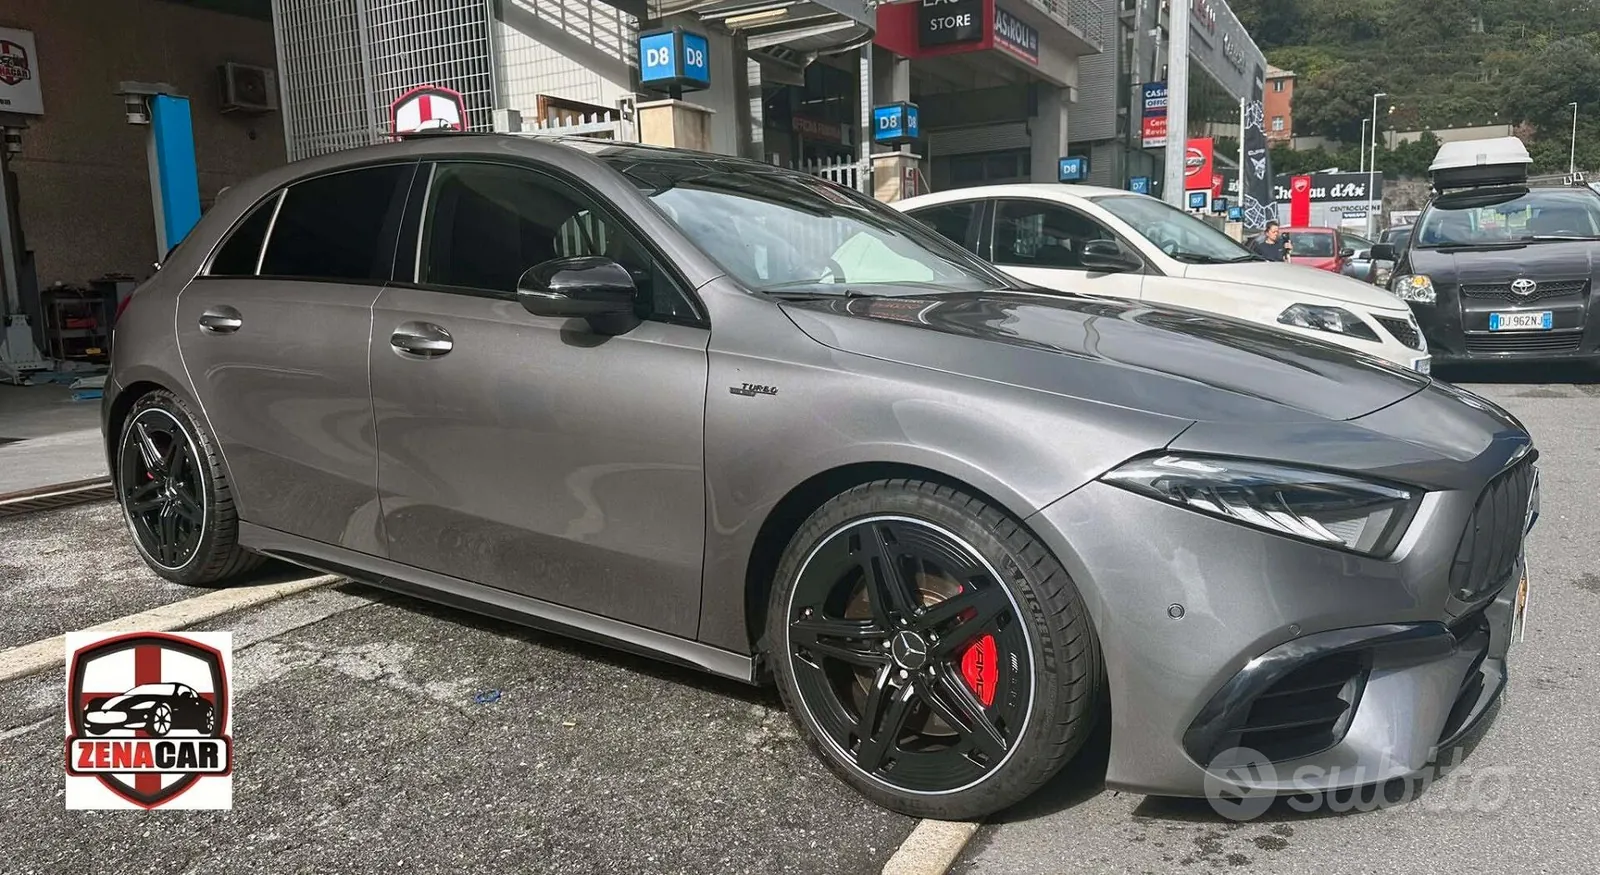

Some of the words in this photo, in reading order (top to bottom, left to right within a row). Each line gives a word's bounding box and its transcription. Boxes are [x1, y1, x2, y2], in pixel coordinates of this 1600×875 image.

[930, 14, 971, 31] STORE
[994, 10, 1030, 49] ASiROLI
[646, 46, 670, 68] D8
[686, 47, 703, 68] D8
[880, 115, 898, 129] D8
[907, 115, 917, 128] D8
[1063, 164, 1077, 174] D8
[1499, 316, 1511, 327] DJ
[1513, 315, 1543, 327] 962NJ
[742, 383, 778, 393] TURBO
[1016, 577, 1057, 673] MICHELIN
